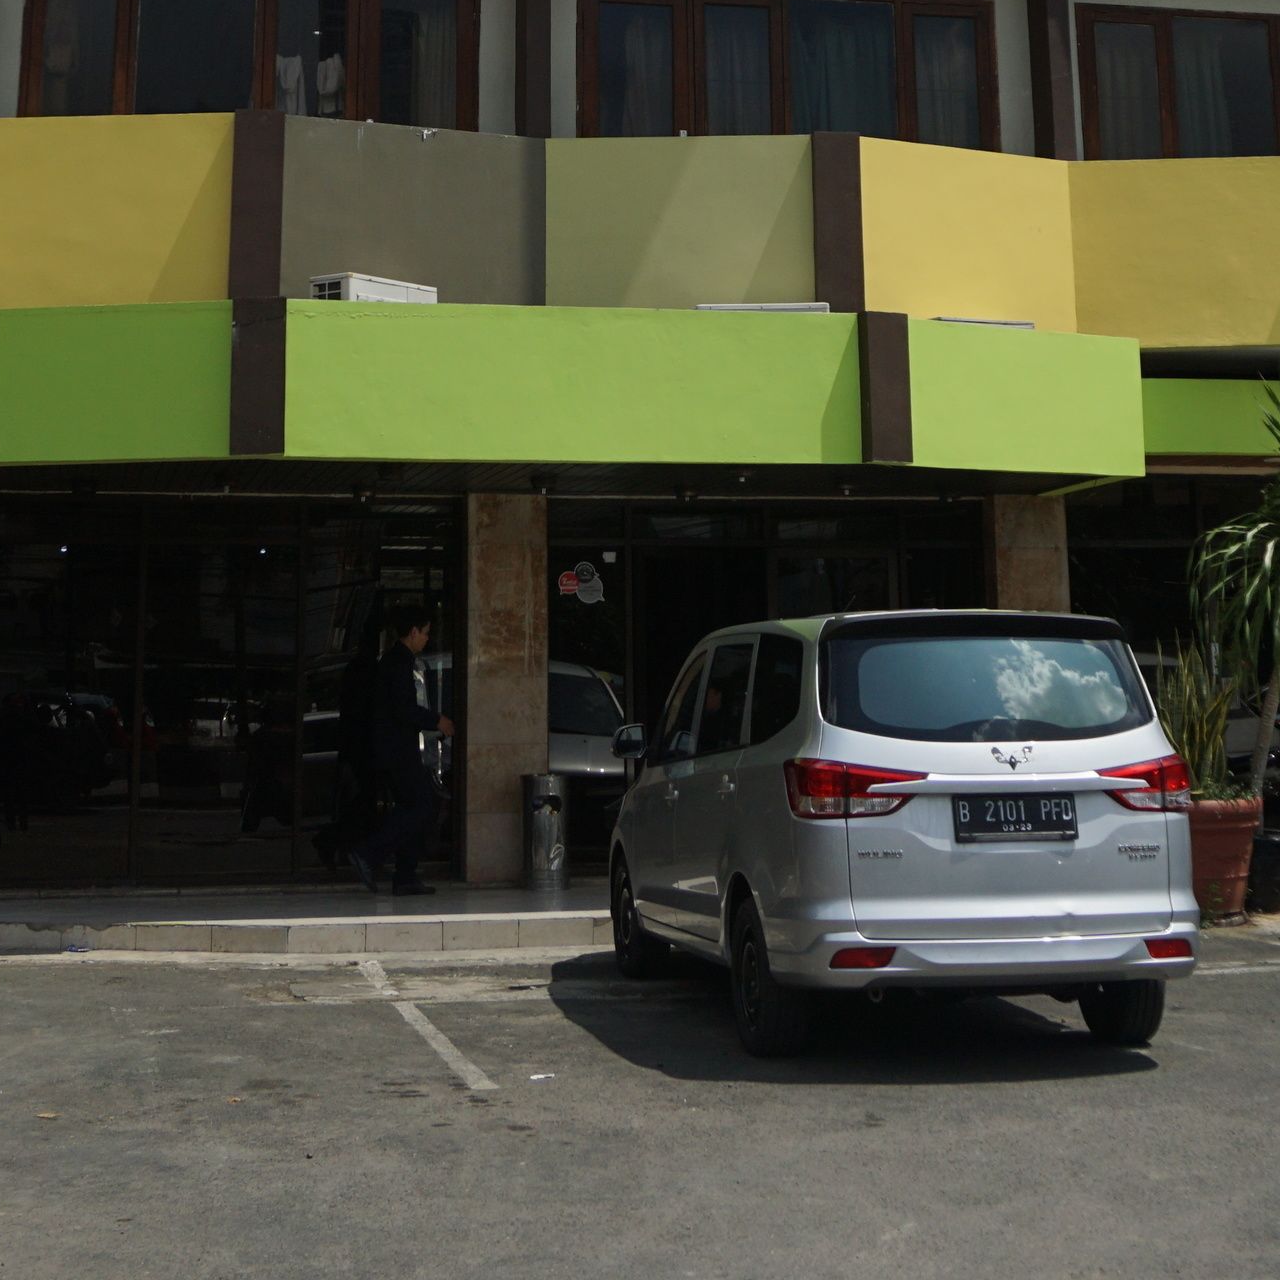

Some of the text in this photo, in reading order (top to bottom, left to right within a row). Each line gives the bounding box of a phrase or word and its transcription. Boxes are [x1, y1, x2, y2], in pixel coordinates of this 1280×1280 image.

[959, 799, 1073, 822] B 2101 PFD
